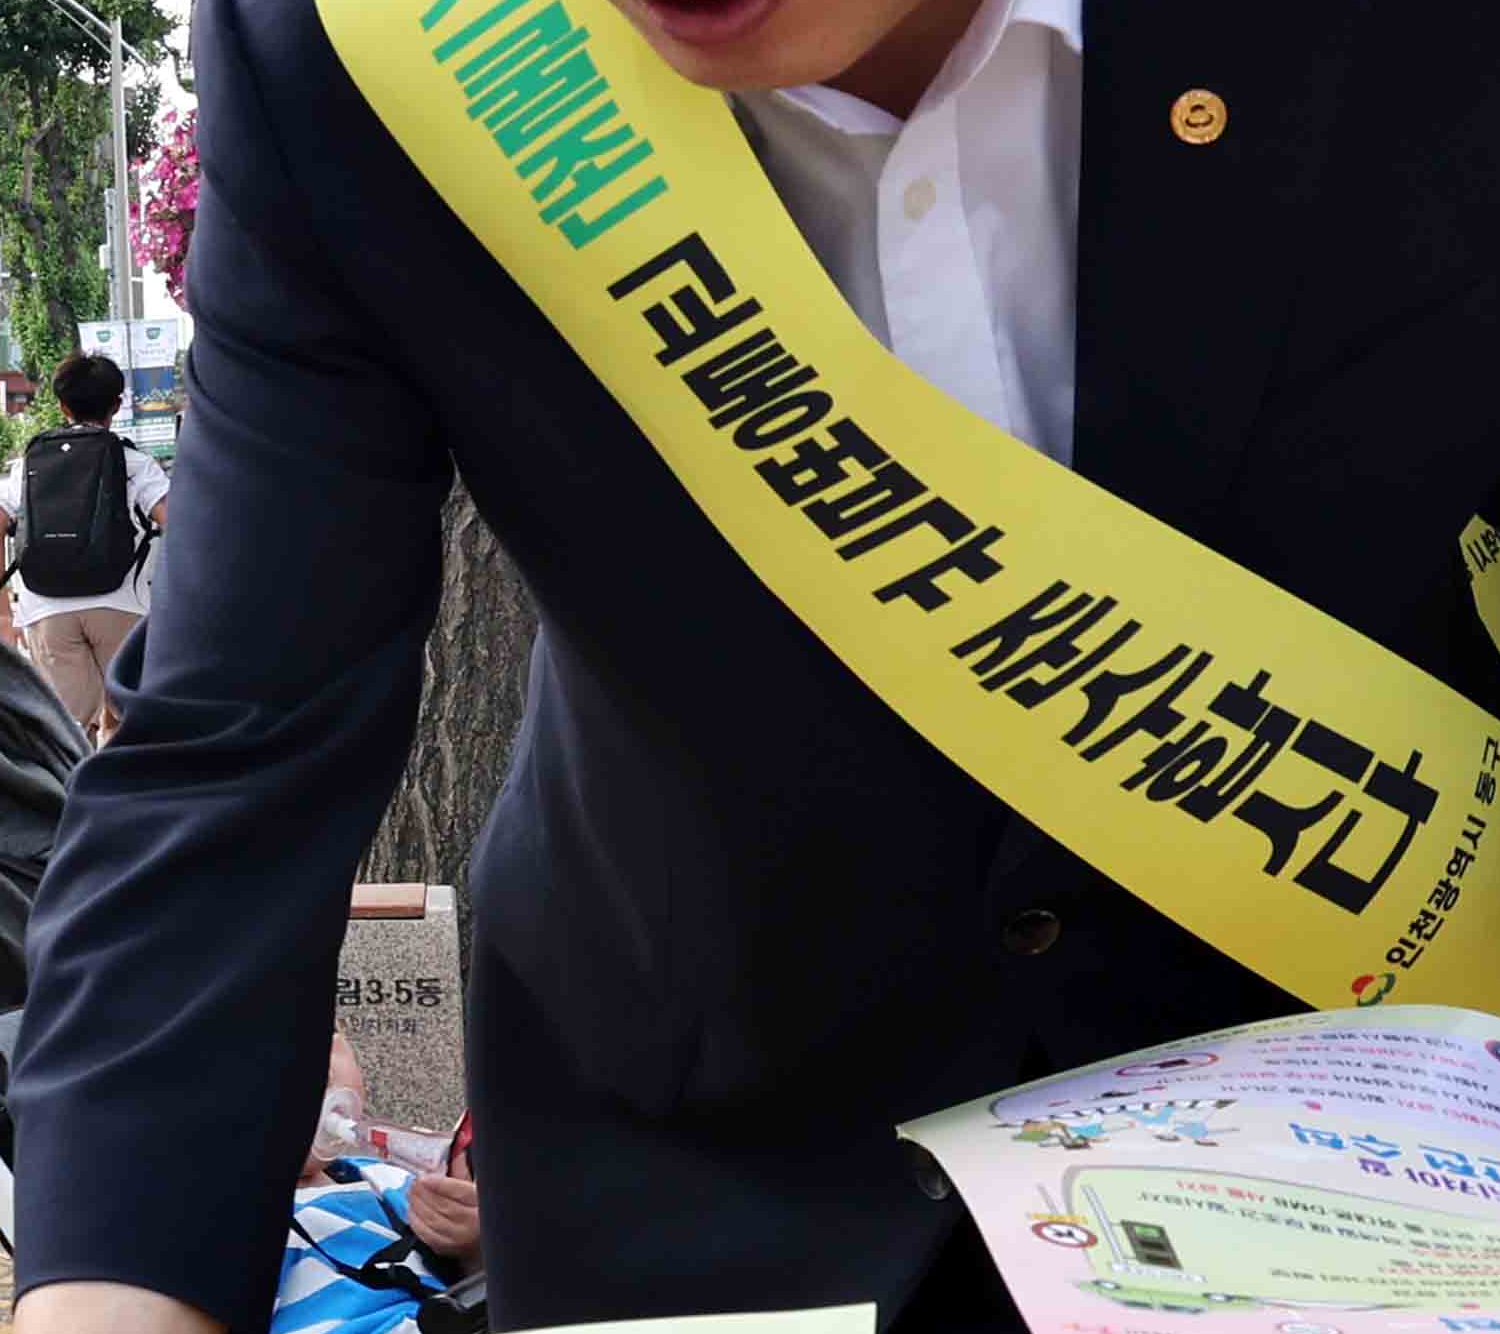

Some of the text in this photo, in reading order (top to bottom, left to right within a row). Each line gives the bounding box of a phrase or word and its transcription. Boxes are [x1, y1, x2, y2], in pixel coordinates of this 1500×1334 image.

[605, 230, 1440, 915] 교통법규 준수합시다
[1385, 813, 1488, 969] 인천광역시
[336, 978, 442, 1007] 림3·5동
